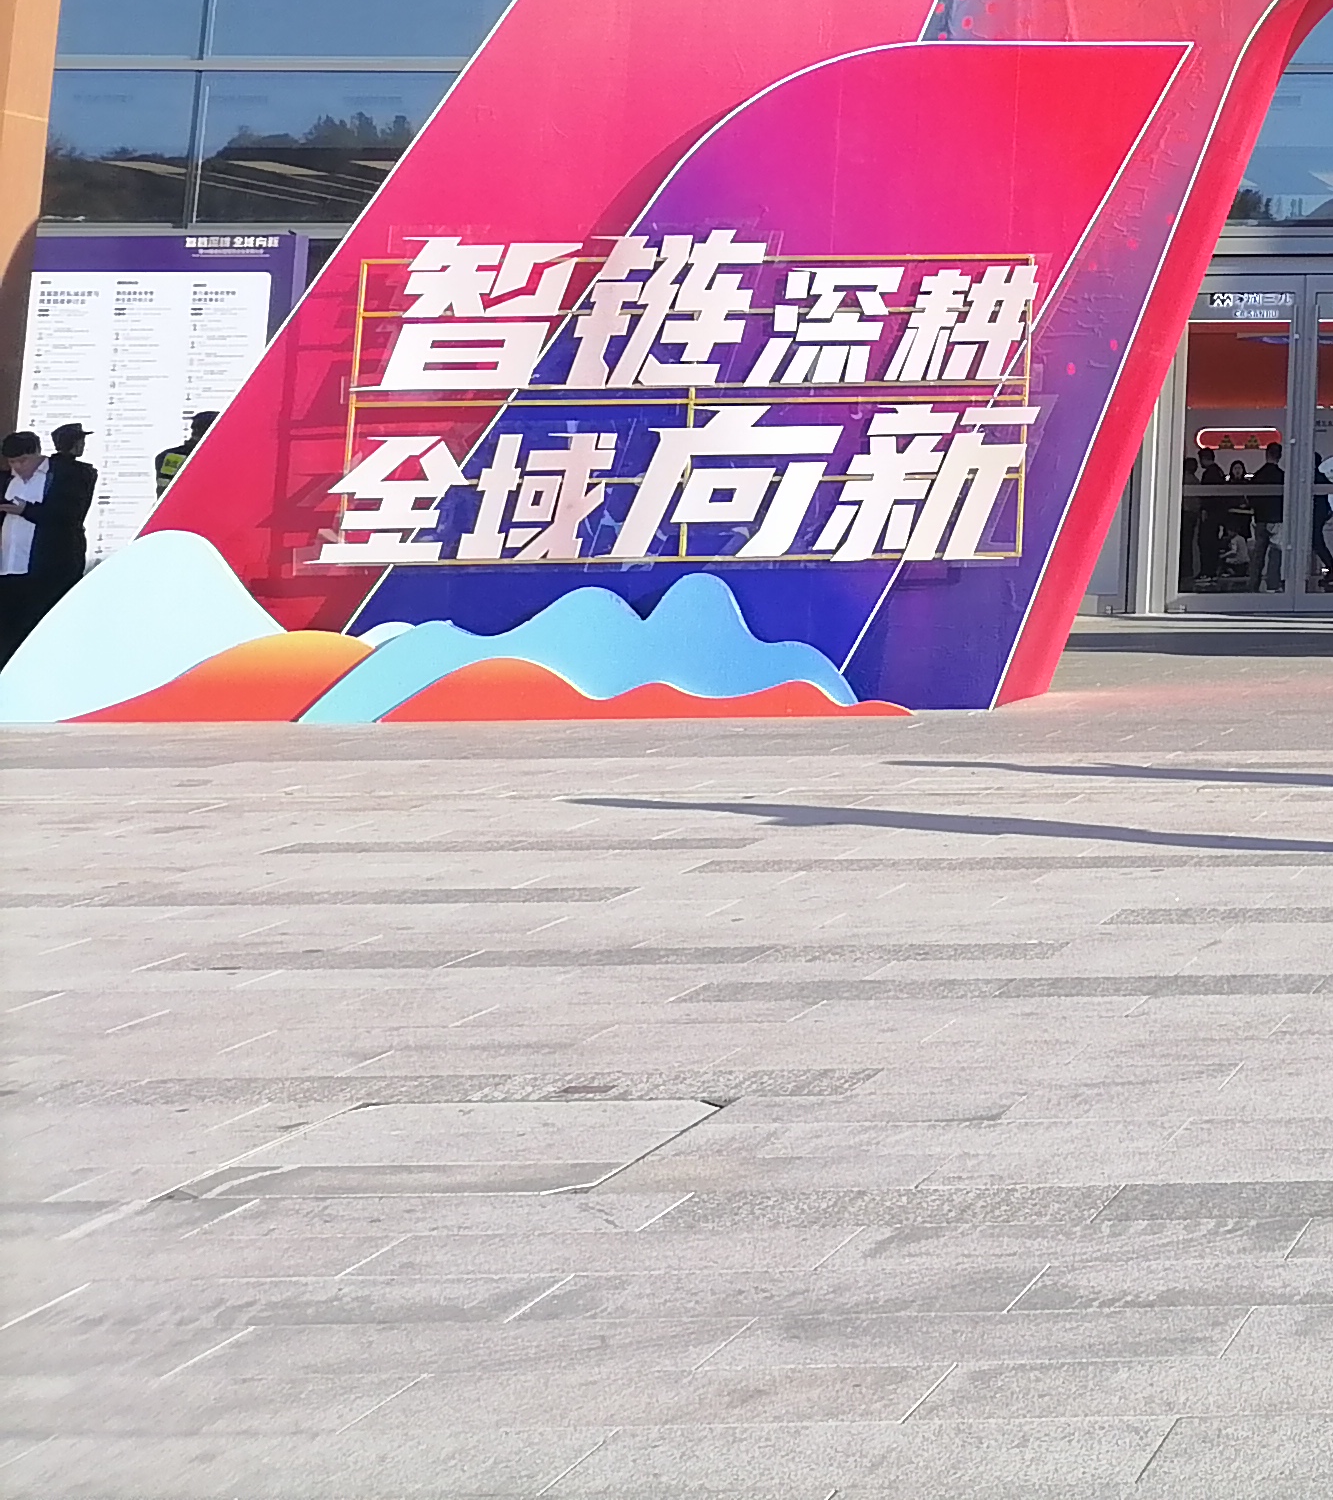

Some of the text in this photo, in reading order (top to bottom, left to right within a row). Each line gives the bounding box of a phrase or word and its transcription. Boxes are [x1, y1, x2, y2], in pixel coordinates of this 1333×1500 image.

[350, 229, 1040, 391] 智链深耕
[303, 405, 1042, 566] 全域向新
